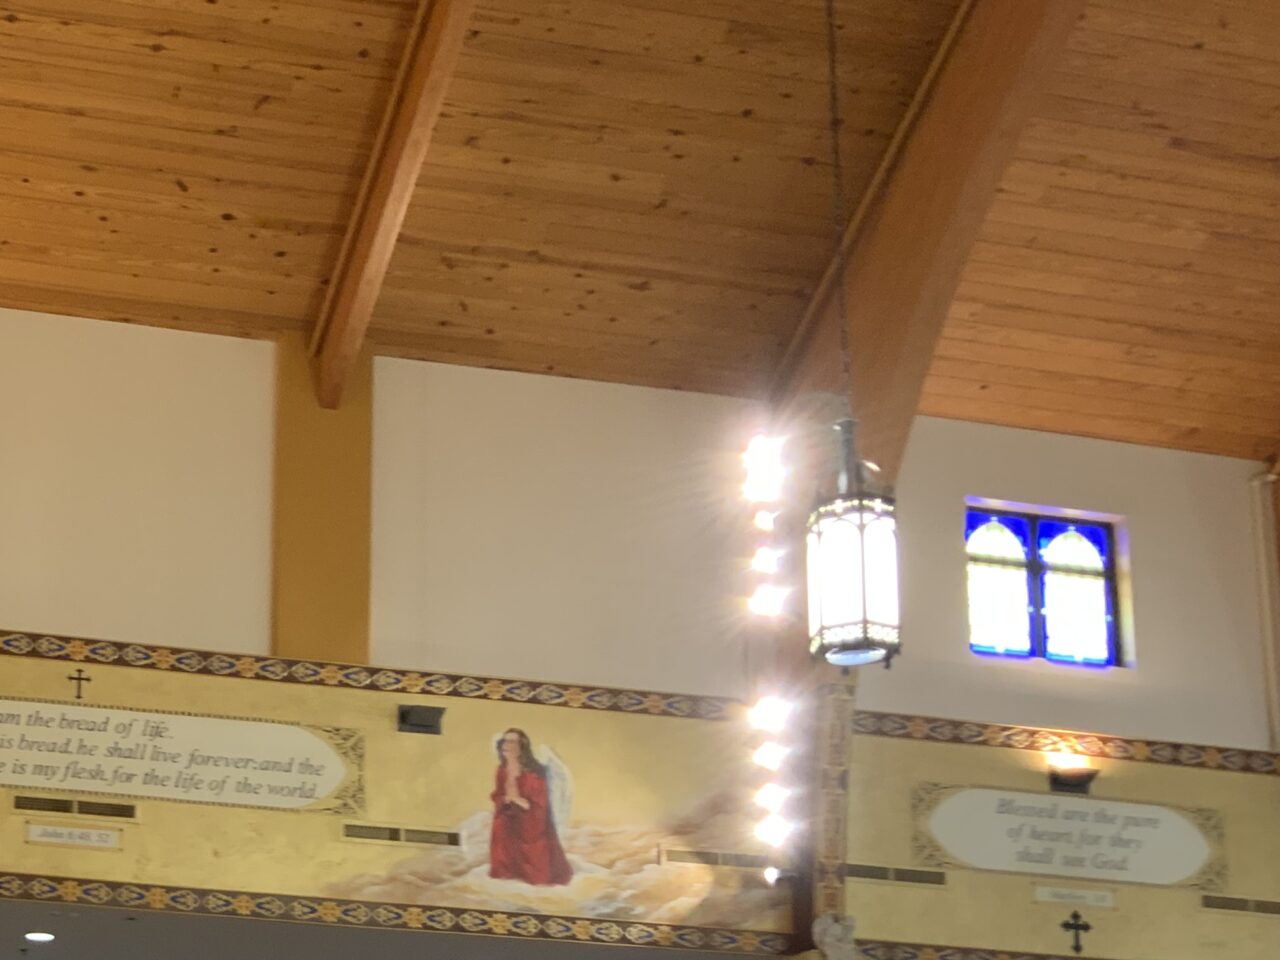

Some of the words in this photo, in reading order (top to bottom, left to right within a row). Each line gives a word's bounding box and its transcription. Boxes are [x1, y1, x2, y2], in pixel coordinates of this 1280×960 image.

[25, 710, 56, 728] the
[58, 713, 110, 732] bread
[114, 718, 139, 739] of
[104, 741, 148, 760] shall
[150, 745, 182, 763] live
[297, 757, 326, 776] the
[11, 758, 28, 775] is
[31, 763, 60, 780] my
[105, 765, 138, 786] for
[142, 769, 171, 787] the
[173, 770, 205, 793] life
[207, 775, 231, 795] of
[235, 777, 263, 795] the
